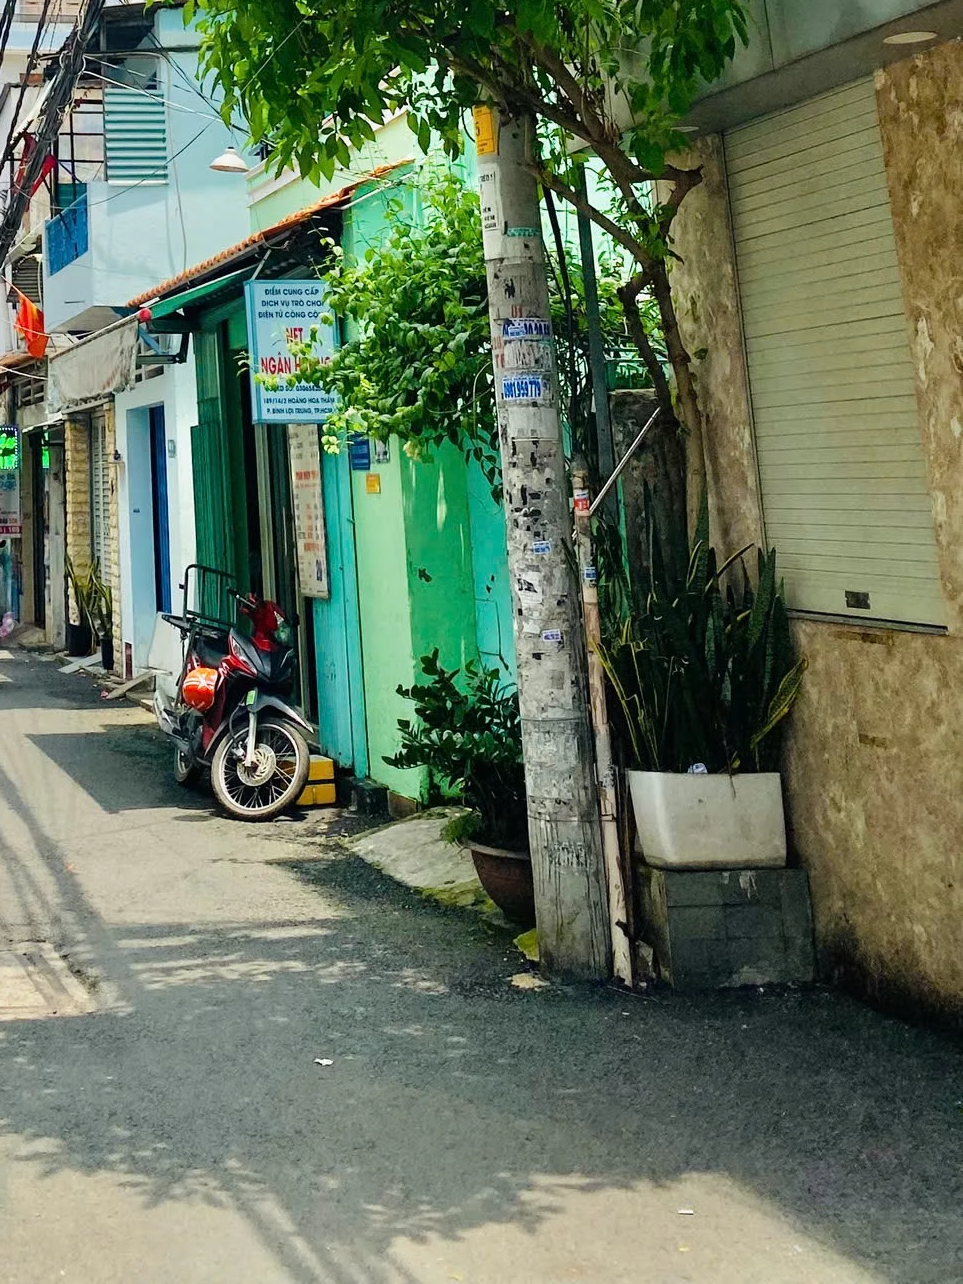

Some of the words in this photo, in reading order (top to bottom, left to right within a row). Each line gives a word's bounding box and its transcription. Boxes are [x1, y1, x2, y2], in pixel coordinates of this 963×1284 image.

[283, 288, 303, 296] CUNG
[304, 286, 319, 296] CẤP
[261, 300, 279, 308] DỊCH
[291, 298, 304, 307] TRÒ
[284, 310, 306, 318] CÔNG
[260, 351, 292, 375] NGÂN
[288, 396, 307, 404] HOÀNG
